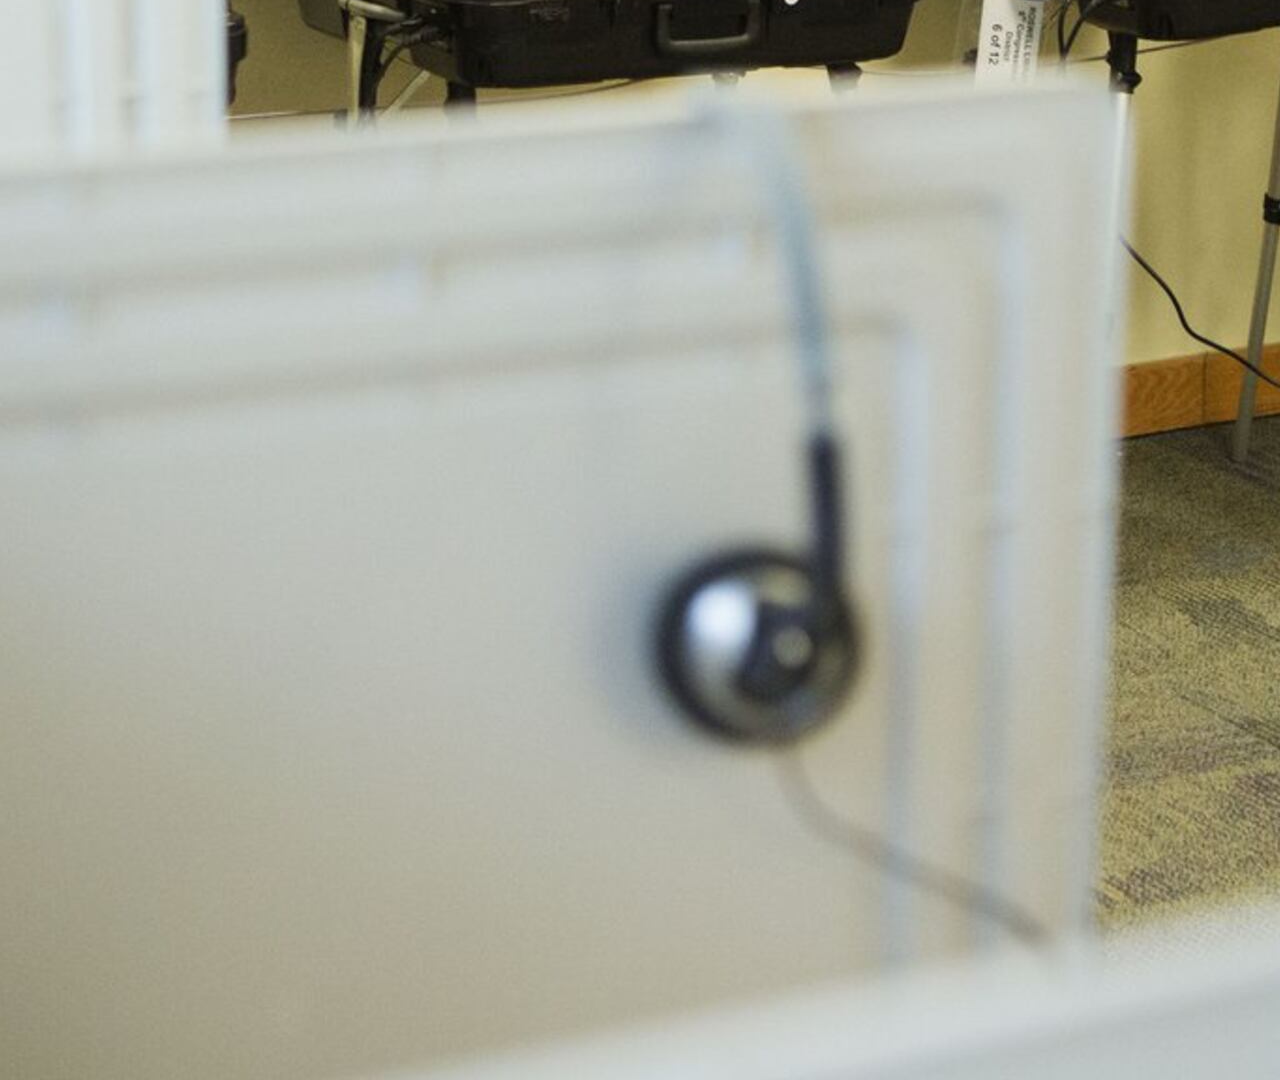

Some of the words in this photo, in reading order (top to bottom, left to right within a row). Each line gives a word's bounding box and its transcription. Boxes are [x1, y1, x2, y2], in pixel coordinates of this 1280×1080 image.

[991, 23, 1003, 32] 6
[1024, 6, 1037, 50] ROSWELL
[990, 35, 1001, 48] of
[1003, 31, 1014, 62] District
[987, 52, 999, 66] 12
